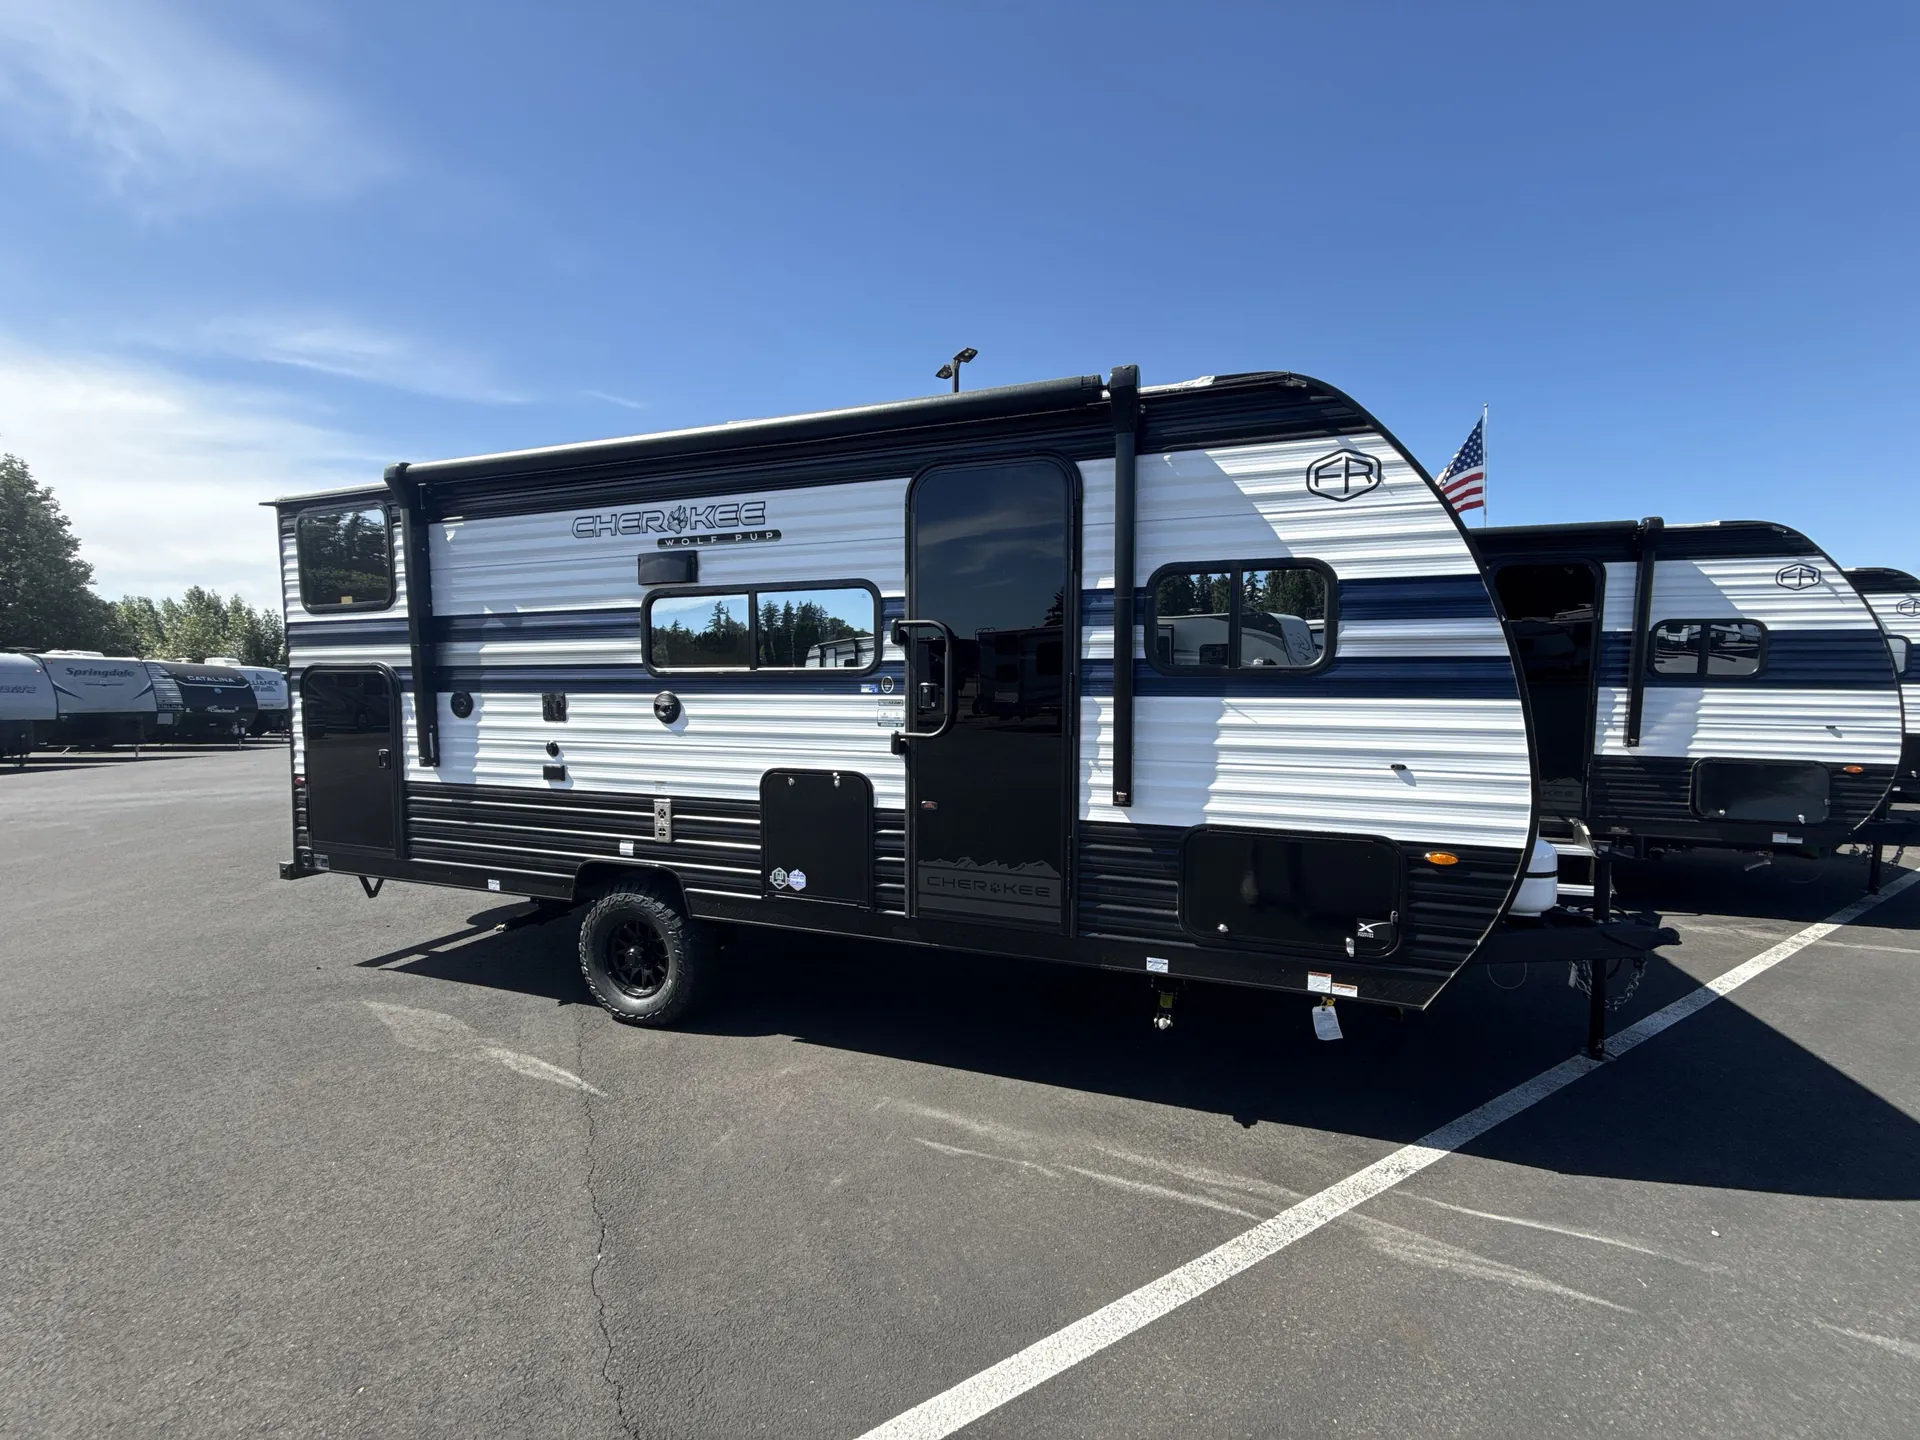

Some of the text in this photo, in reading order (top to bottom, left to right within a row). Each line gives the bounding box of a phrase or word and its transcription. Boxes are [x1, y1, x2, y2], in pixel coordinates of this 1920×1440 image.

[572, 501, 766, 538] CHEROKEE
[664, 532, 773, 547] WOLF PUP
[65, 667, 136, 678] Springdale
[186, 675, 236, 683] CATALINA
[926, 876, 1051, 898] CHEROKEE
